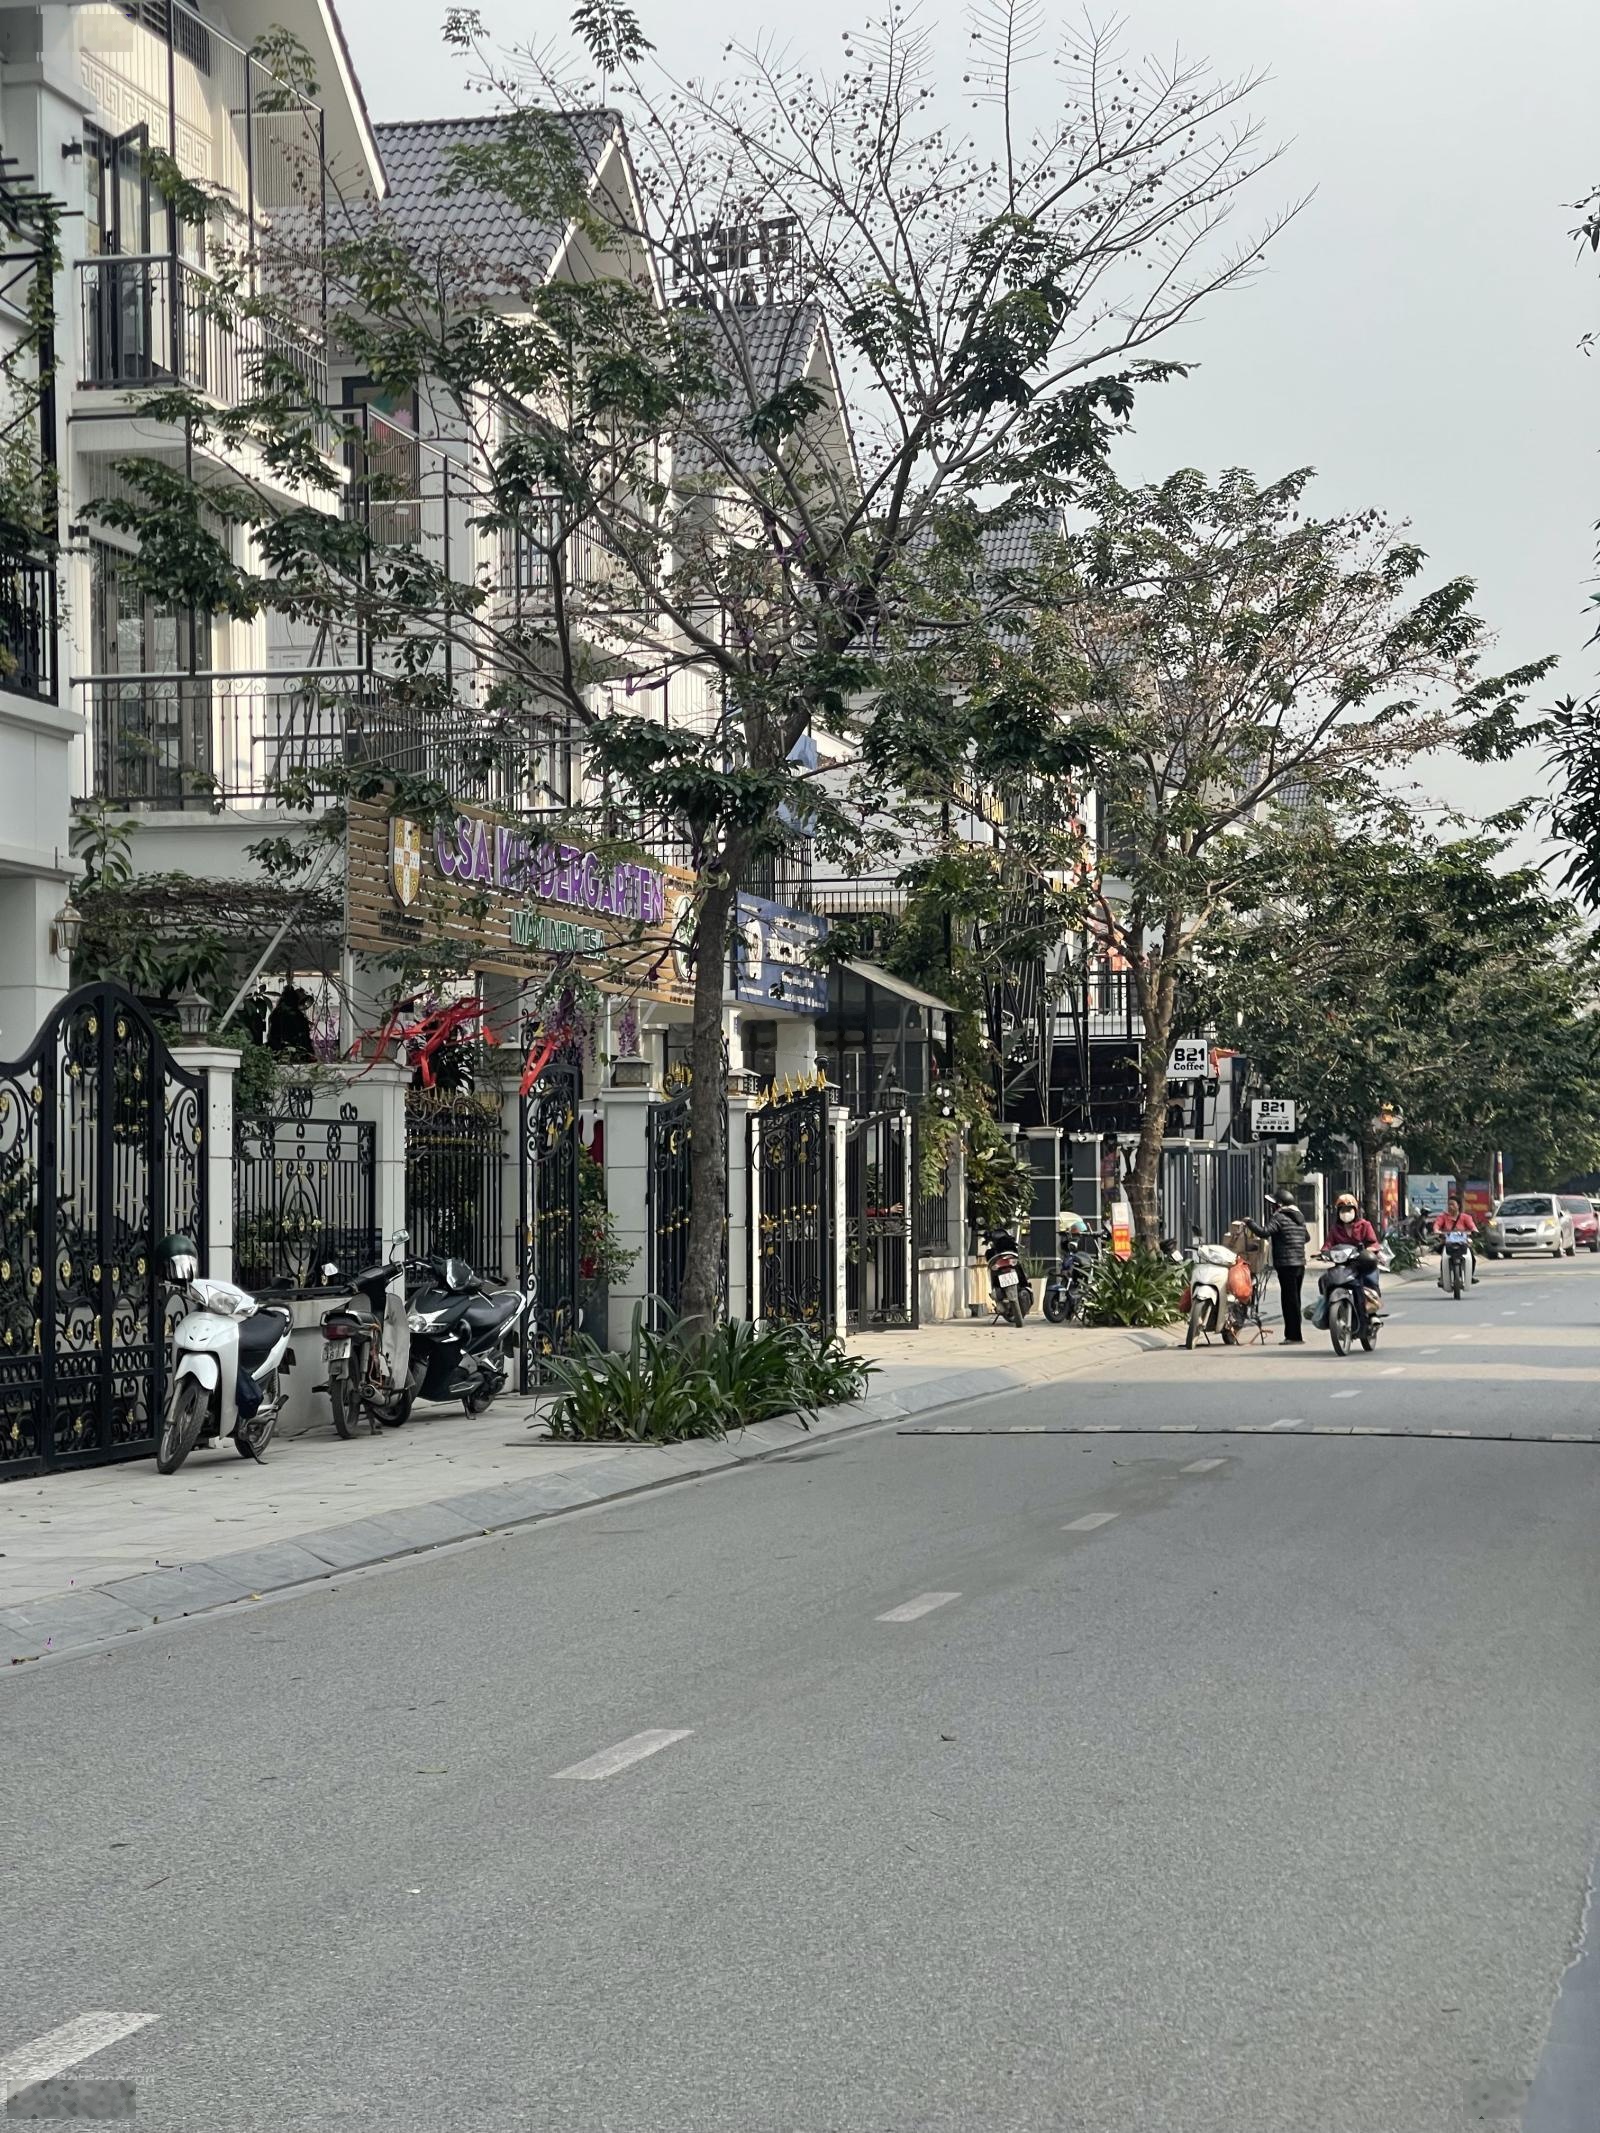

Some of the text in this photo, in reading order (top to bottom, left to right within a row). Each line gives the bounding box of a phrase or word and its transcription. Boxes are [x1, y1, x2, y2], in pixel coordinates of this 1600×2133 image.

[434, 814, 492, 885] CSA
[550, 918, 578, 954] NON
[1174, 1047, 1205, 1061] B21
[1173, 1061, 1205, 1071] Coffee
[1261, 1101, 1285, 1113] B21
